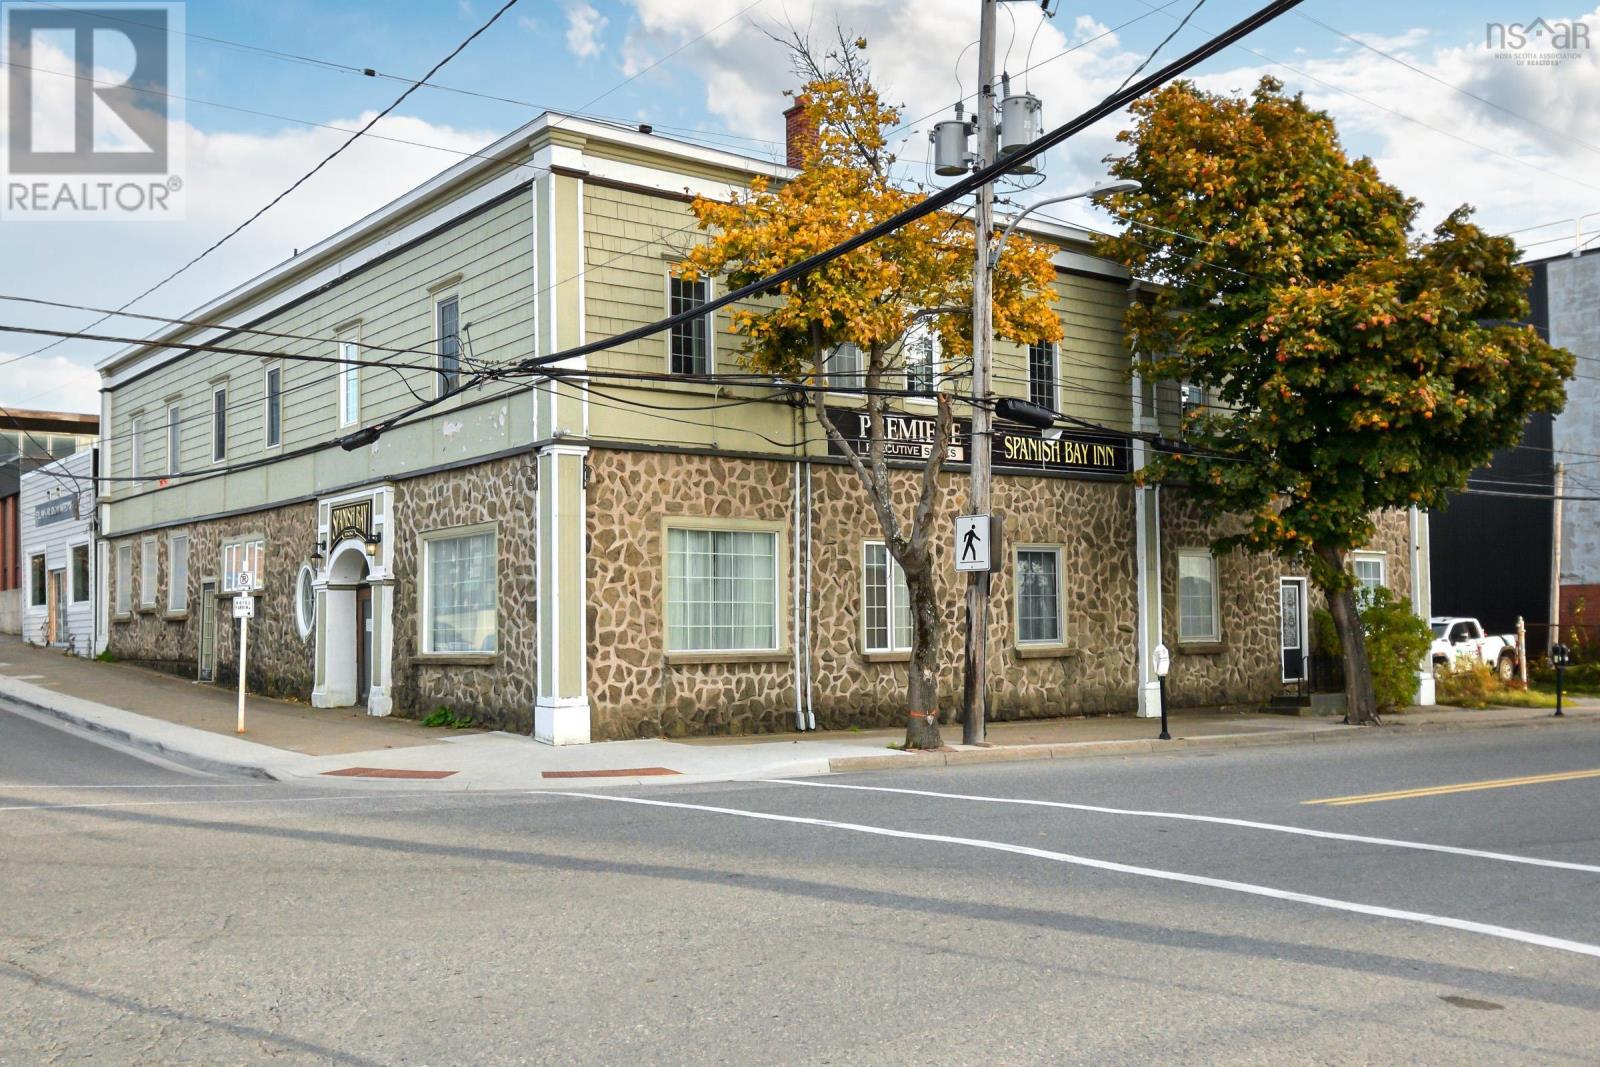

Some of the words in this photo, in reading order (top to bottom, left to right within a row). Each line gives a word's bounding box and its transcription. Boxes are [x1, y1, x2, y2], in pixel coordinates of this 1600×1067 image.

[858, 414, 962, 445] PEMIEE
[1004, 435, 1060, 462] SPANISH
[1065, 441, 1089, 464] BAY
[1093, 444, 1115, 466] INN
